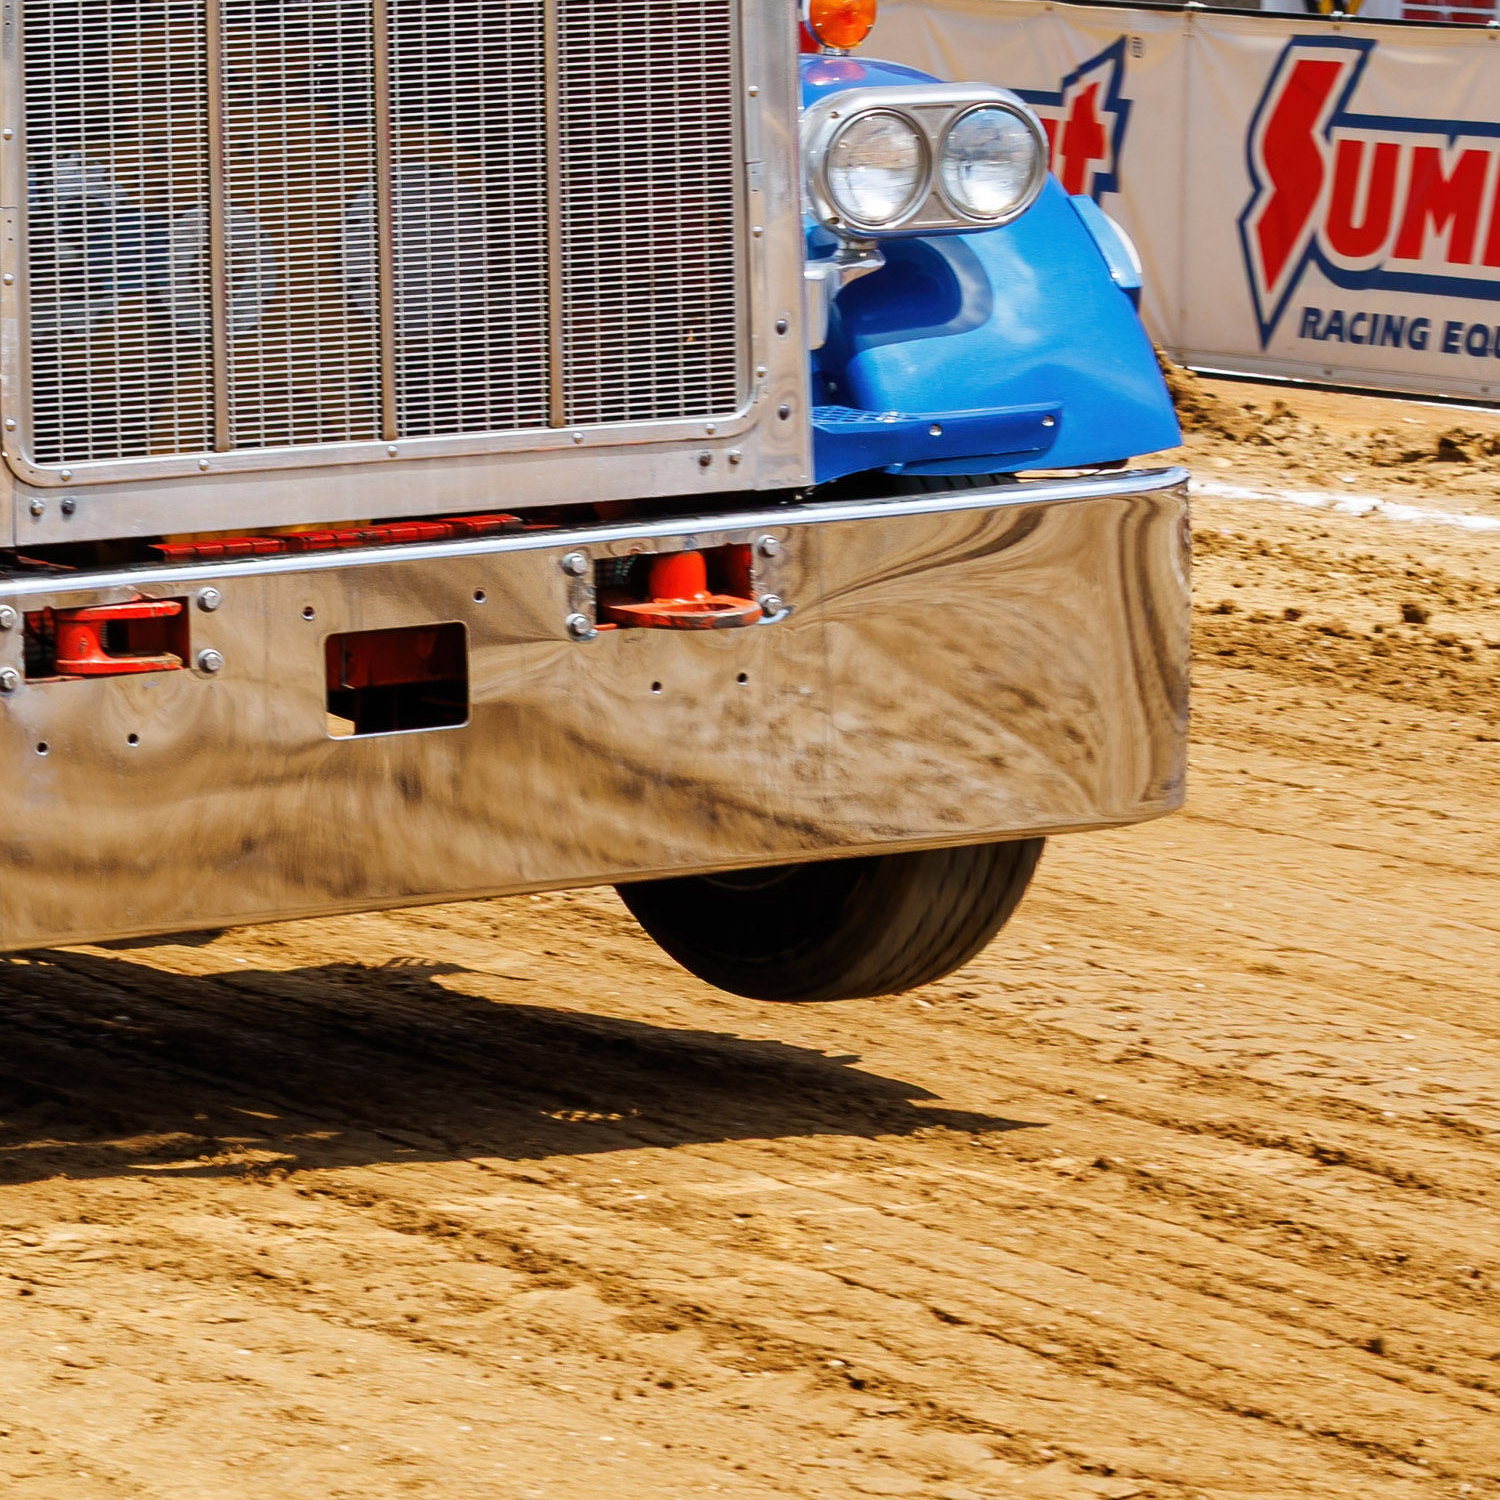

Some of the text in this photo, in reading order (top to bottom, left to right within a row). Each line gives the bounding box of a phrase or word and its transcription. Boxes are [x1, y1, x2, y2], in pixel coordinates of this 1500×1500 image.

[1250, 50, 1500, 300] SUM
[1298, 306, 1500, 359] RACING EQ
